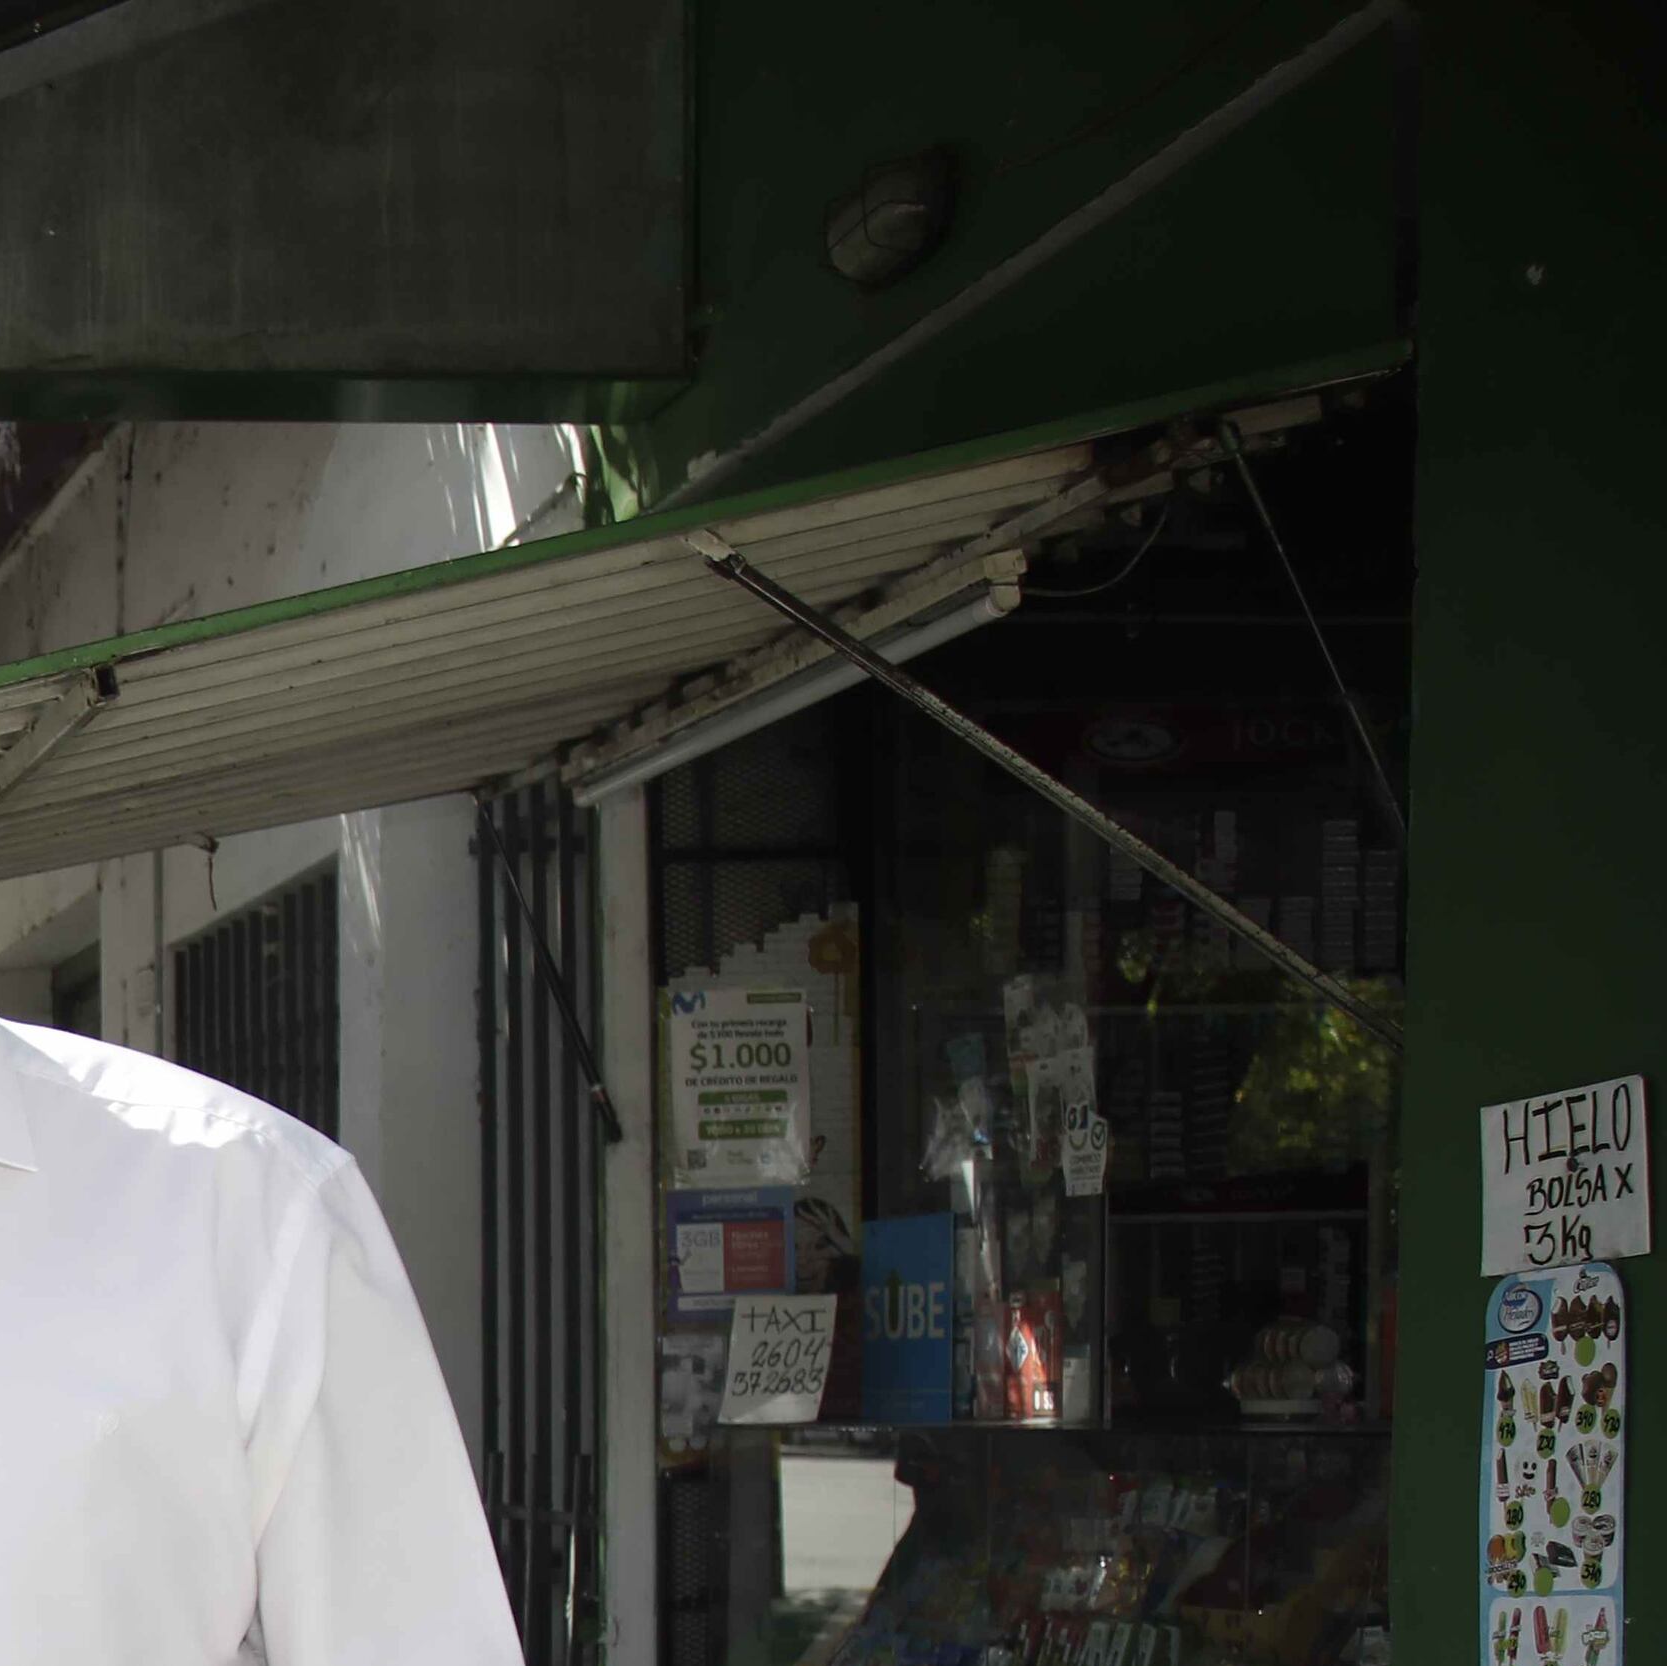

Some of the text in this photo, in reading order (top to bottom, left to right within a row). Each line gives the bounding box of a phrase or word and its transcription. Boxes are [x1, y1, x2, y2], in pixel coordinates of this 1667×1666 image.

[690, 1041, 792, 1074] $1.000
[686, 1077, 699, 1087] DE
[760, 1073, 798, 1085] REGALO
[1503, 1083, 1632, 1175] HIELO
[1524, 1163, 1634, 1216] BOLSA X
[1524, 1221, 1556, 1265] 3
[741, 1304, 827, 1334] TAXI
[865, 1280, 947, 1342] SUBE
[751, 1337, 827, 1369] 2604
